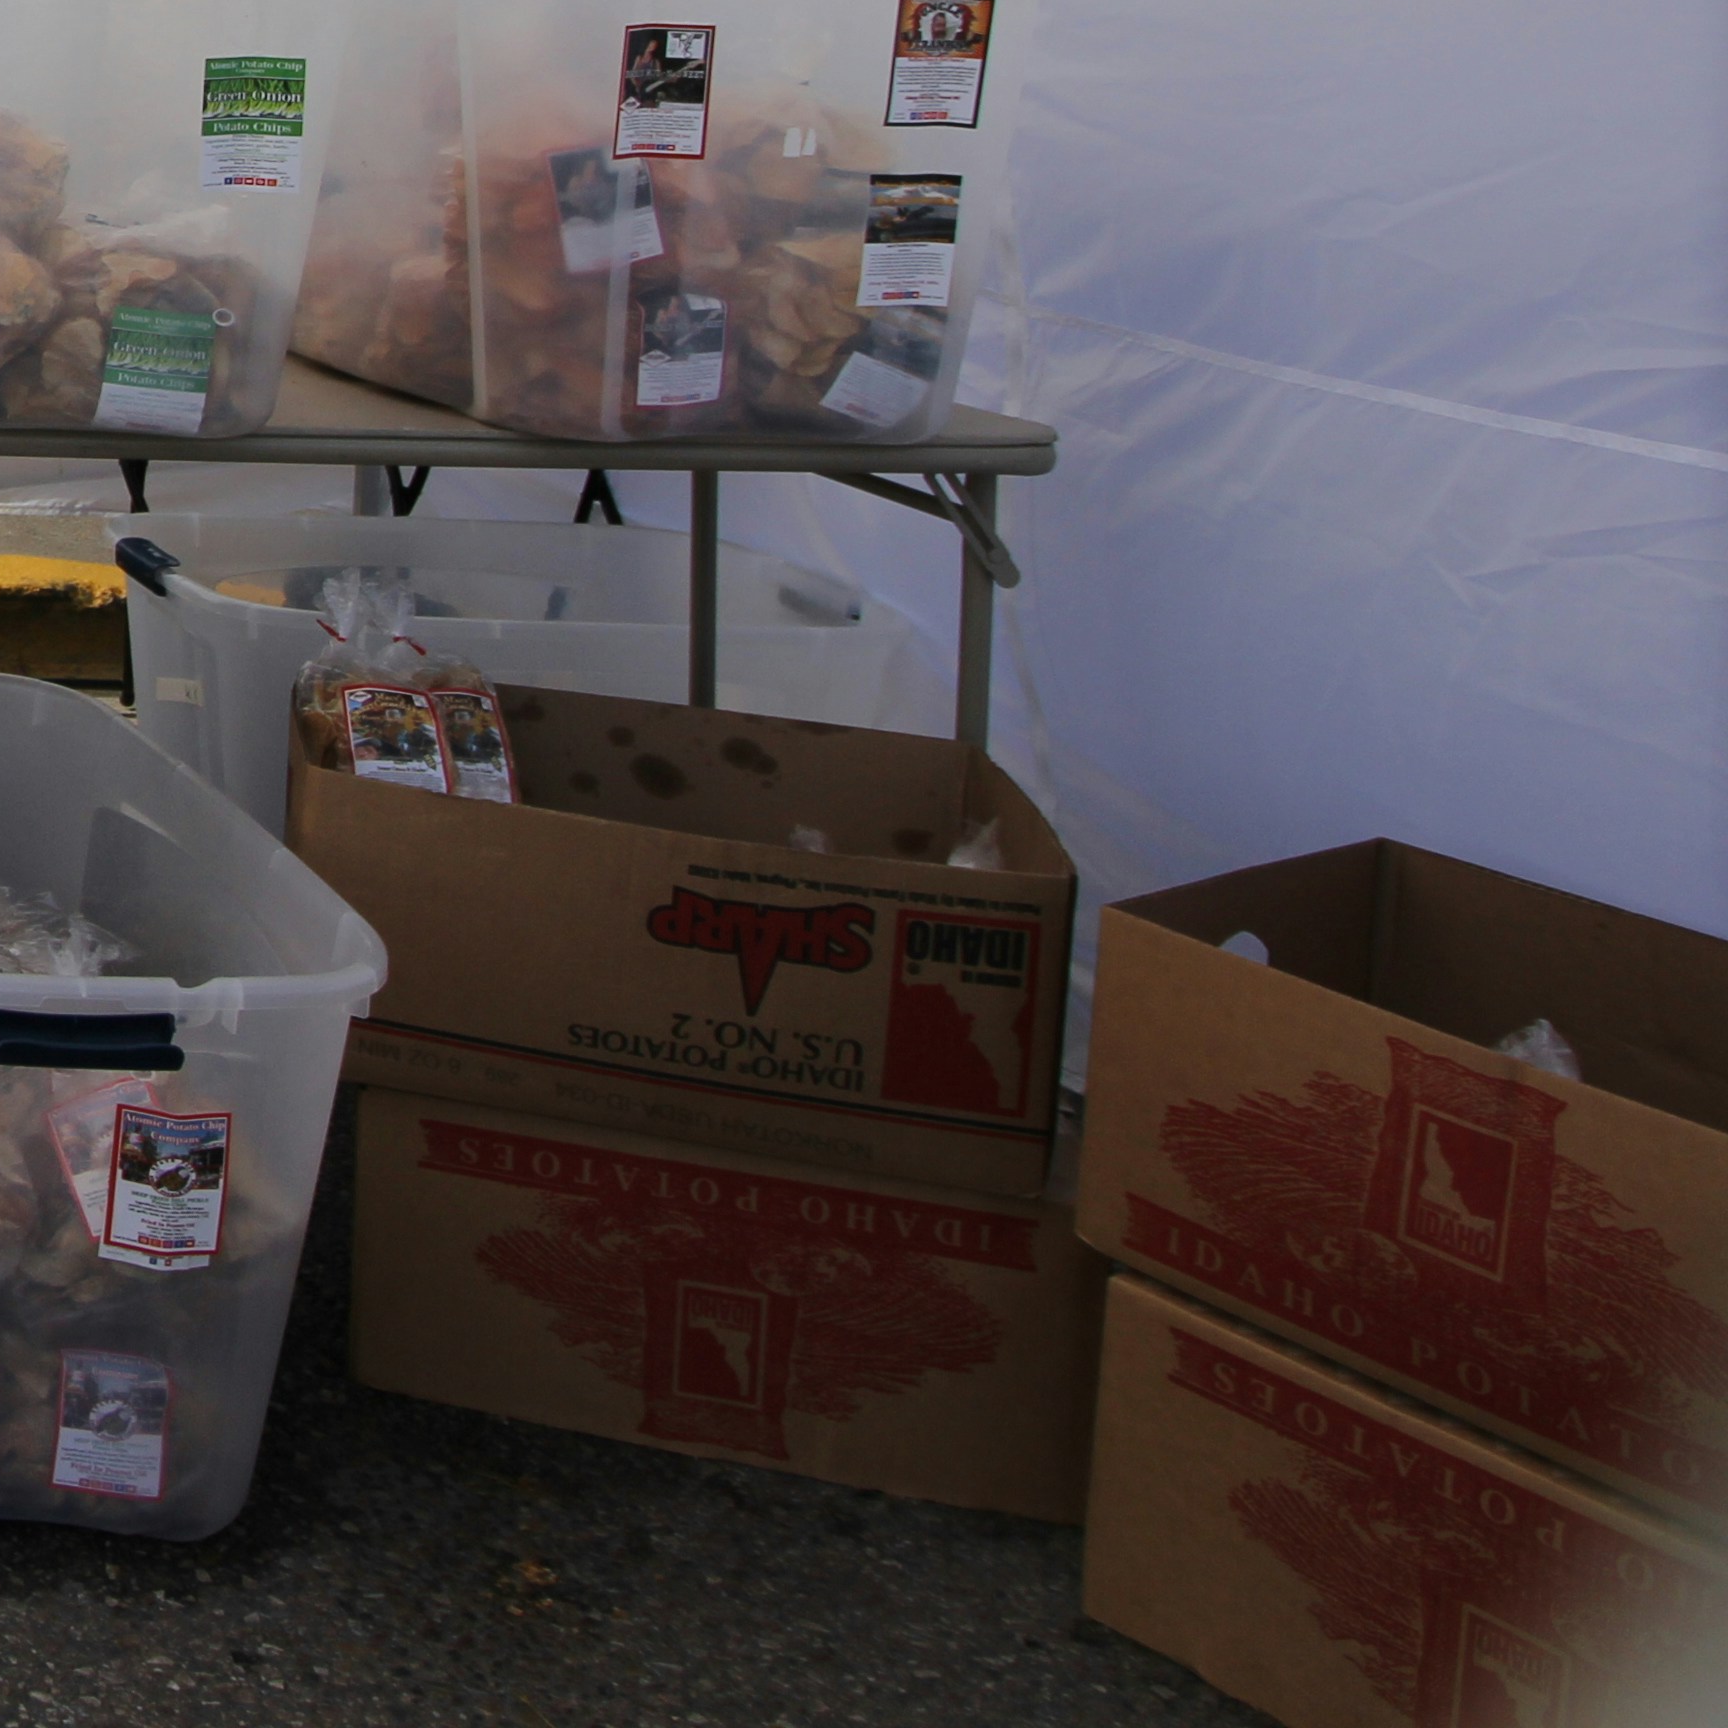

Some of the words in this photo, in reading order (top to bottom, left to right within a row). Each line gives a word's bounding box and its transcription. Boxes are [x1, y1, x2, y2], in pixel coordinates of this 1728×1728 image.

[210, 62, 240, 70] Atomic
[241, 60, 274, 68] Potato
[276, 61, 303, 72] Chip
[207, 91, 246, 102] Green
[252, 89, 301, 103] Onion
[213, 122, 249, 132] Potato
[253, 121, 292, 135] Chips
[113, 341, 158, 356] Green
[163, 347, 206, 360] Onion
[118, 372, 156, 385] Potato
[647, 886, 875, 1017] SHARP
[908, 920, 1027, 970] IDAHO
[672, 1012, 692, 1040] 2
[705, 1018, 778, 1055] NO.
[568, 1022, 728, 1072] POTATOES
[793, 1033, 864, 1067] U.S.
[125, 1113, 163, 1127] Atomic
[166, 1120, 200, 1131] Potato
[201, 1120, 226, 1131] Chip
[150, 1131, 201, 1145] Company
[457, 1137, 760, 1214] POTATOES
[800, 1195, 993, 1253] IDAHO
[1414, 1205, 1496, 1263] IDAHO
[689, 1294, 758, 1328] IDAHO
[1162, 1225, 1366, 1339] IDAHO
[1409, 1335, 1699, 1485] POTATO
[1211, 1361, 1566, 1554] POTATOES
